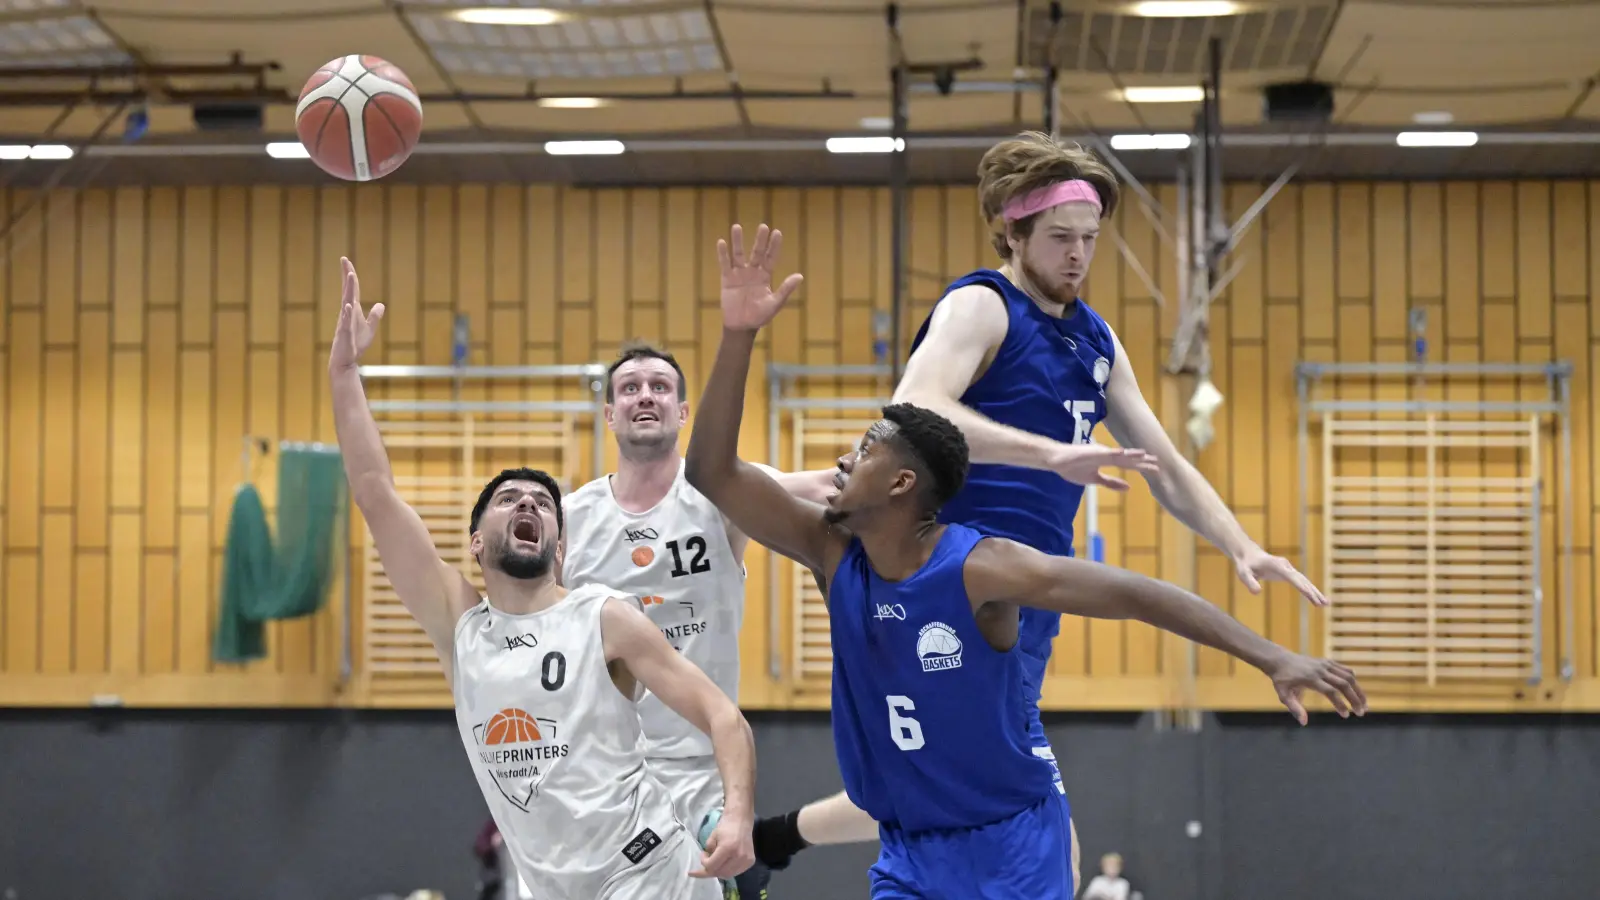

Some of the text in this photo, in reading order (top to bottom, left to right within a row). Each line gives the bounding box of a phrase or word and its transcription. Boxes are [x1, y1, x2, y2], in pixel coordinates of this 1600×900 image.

[665, 535, 712, 578] 12
[540, 651, 567, 692] 0
[922, 655, 961, 671] BASKETS
[885, 694, 926, 751] 6
